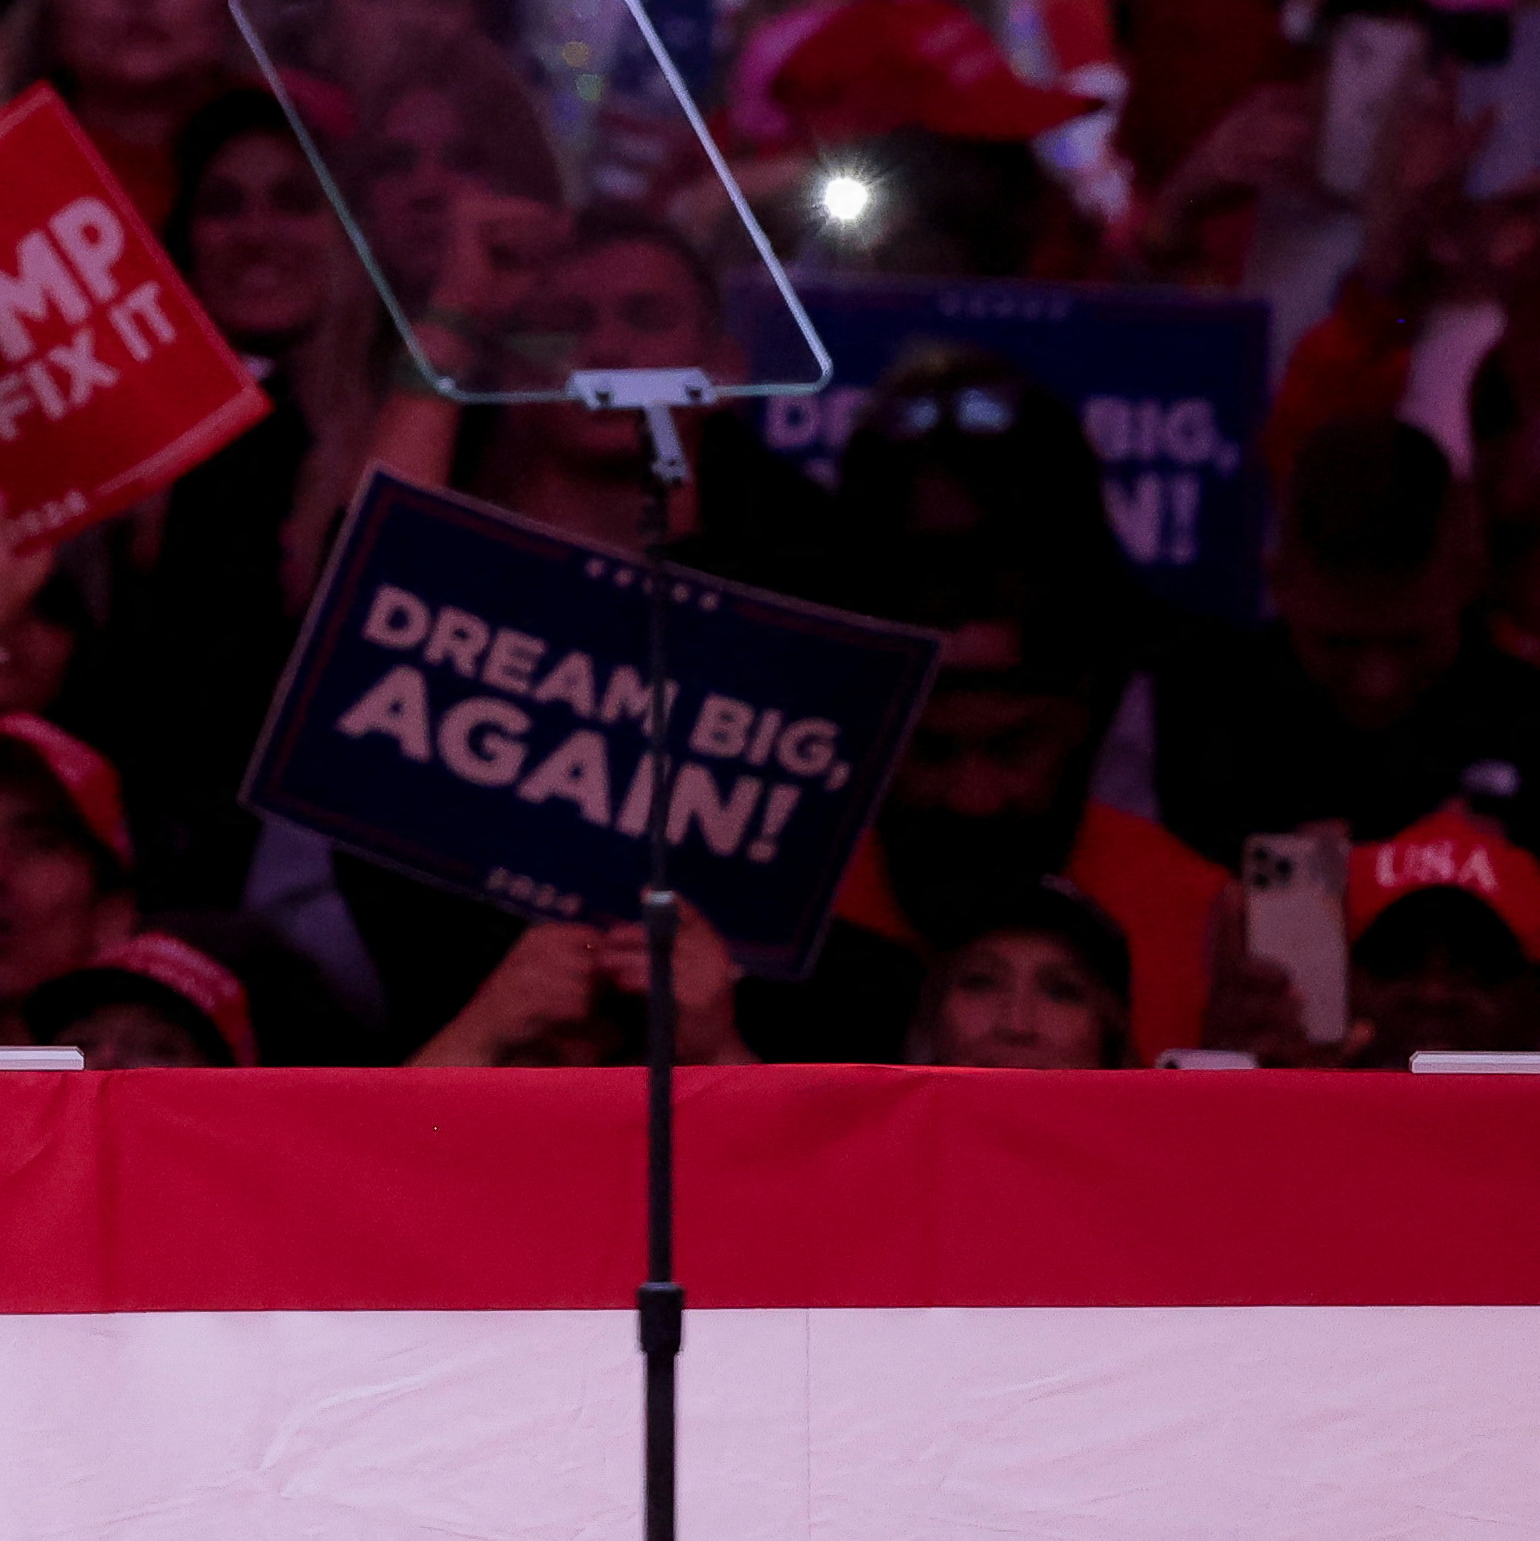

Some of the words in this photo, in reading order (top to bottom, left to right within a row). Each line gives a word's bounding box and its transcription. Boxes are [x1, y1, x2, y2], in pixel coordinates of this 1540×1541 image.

[105, 277, 178, 364] IT
[360, 582, 682, 736] DREAM
[686, 690, 855, 794] BIG,
[333, 663, 805, 864] AGAIN!
[1374, 839, 1502, 894] USA
